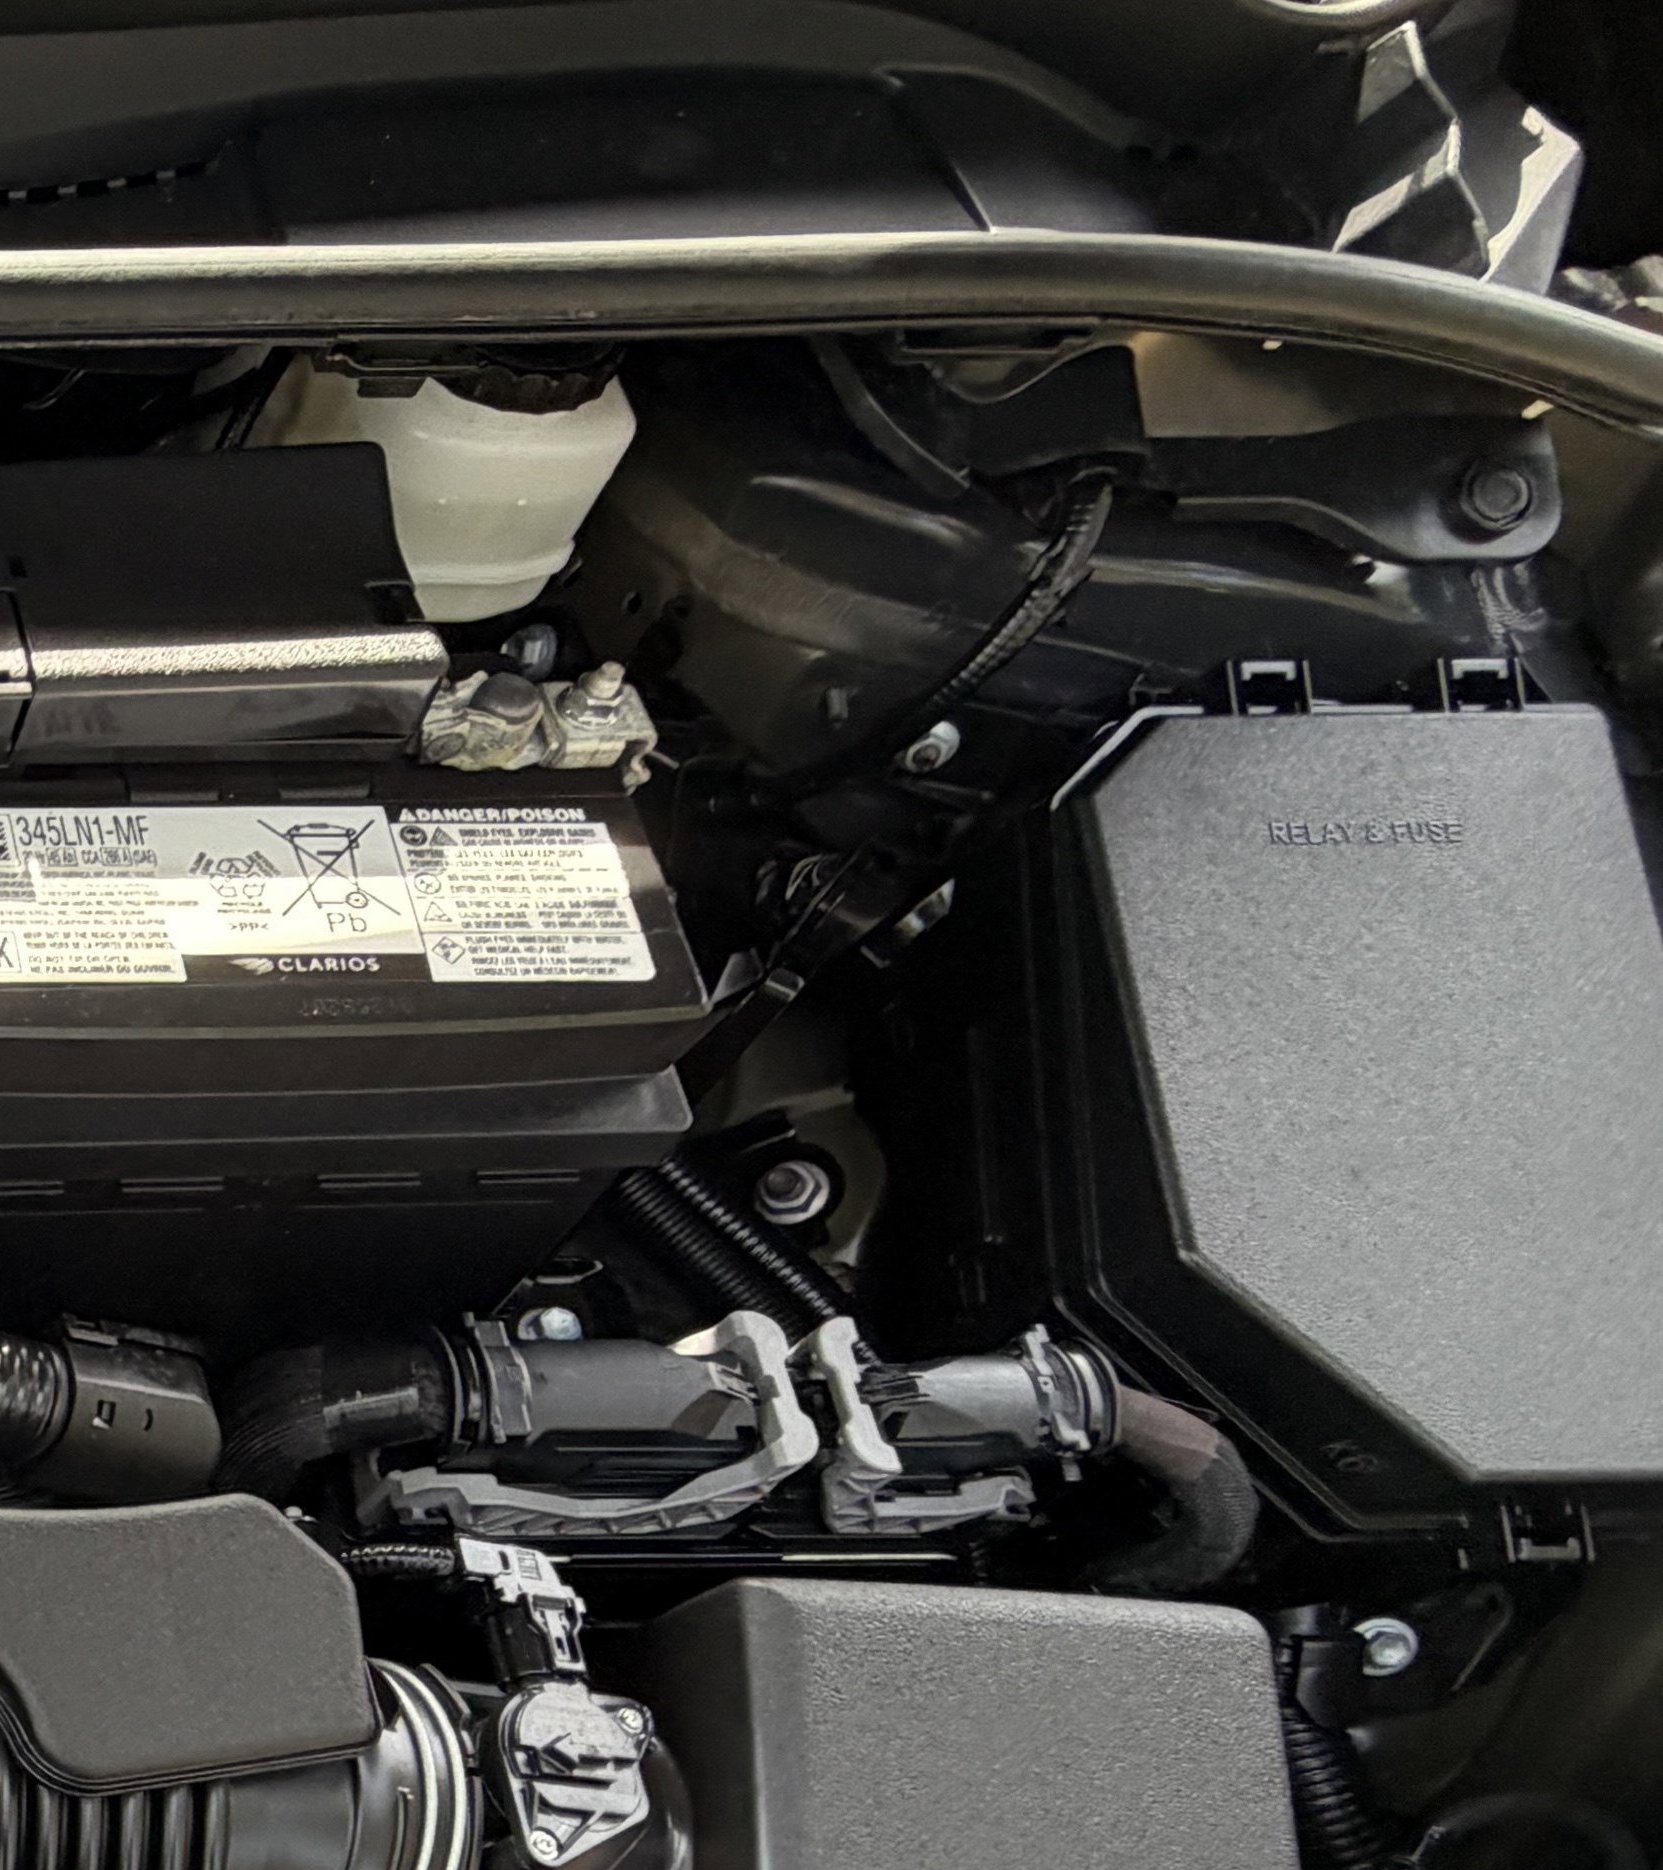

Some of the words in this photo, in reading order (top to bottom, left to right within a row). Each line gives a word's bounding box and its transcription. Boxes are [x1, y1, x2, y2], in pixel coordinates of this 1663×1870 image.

[417, 808, 586, 822] DANGER/POISON
[16, 815, 149, 846] 345LN1-MF
[1268, 820, 1355, 846] RELAY
[1390, 819, 1464, 845] FUSE
[327, 912, 368, 932] Pb
[277, 957, 381, 972] CLARIOS
